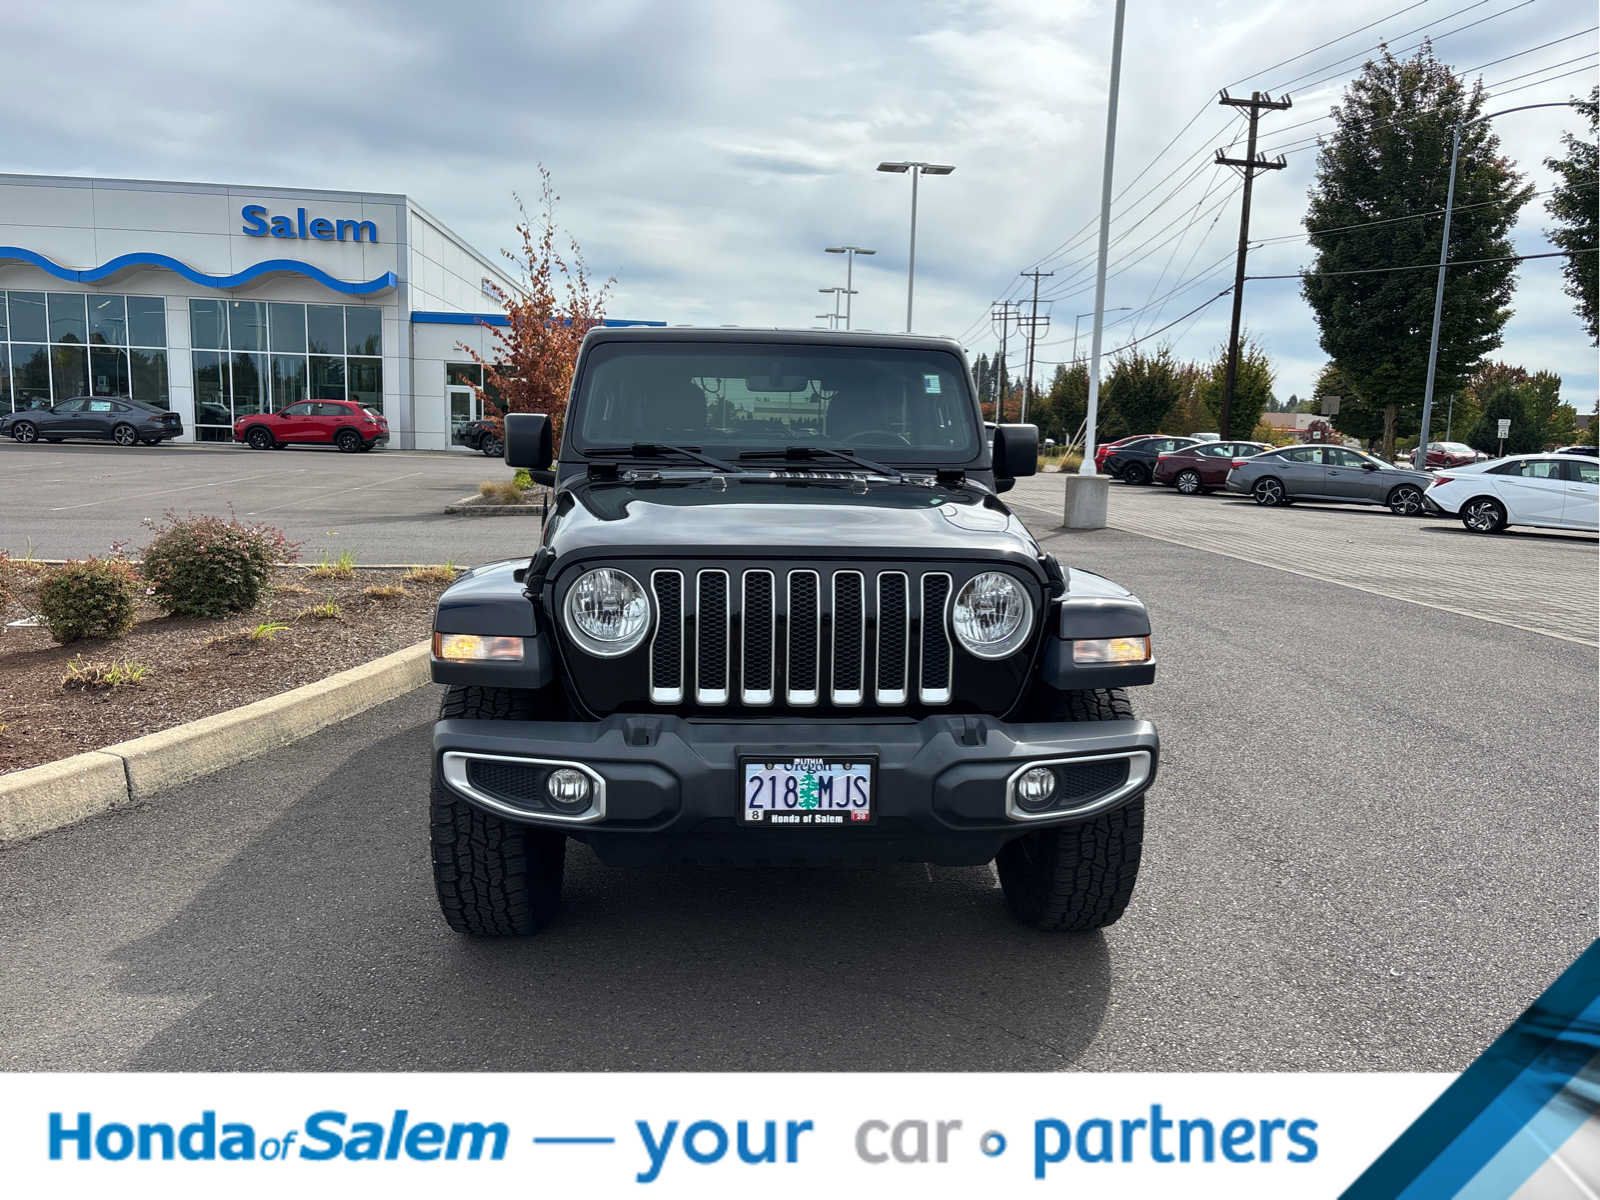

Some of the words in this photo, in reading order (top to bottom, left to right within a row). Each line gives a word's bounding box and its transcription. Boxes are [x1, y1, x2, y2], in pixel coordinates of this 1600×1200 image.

[241, 204, 378, 243] Salem
[783, 762, 833, 775] Oregon
[748, 775, 799, 809] 218
[818, 775, 868, 809] MJS
[751, 810, 760, 820] 8
[771, 814, 801, 824] Honda
[802, 814, 813, 824] of
[815, 814, 844, 824] Salem
